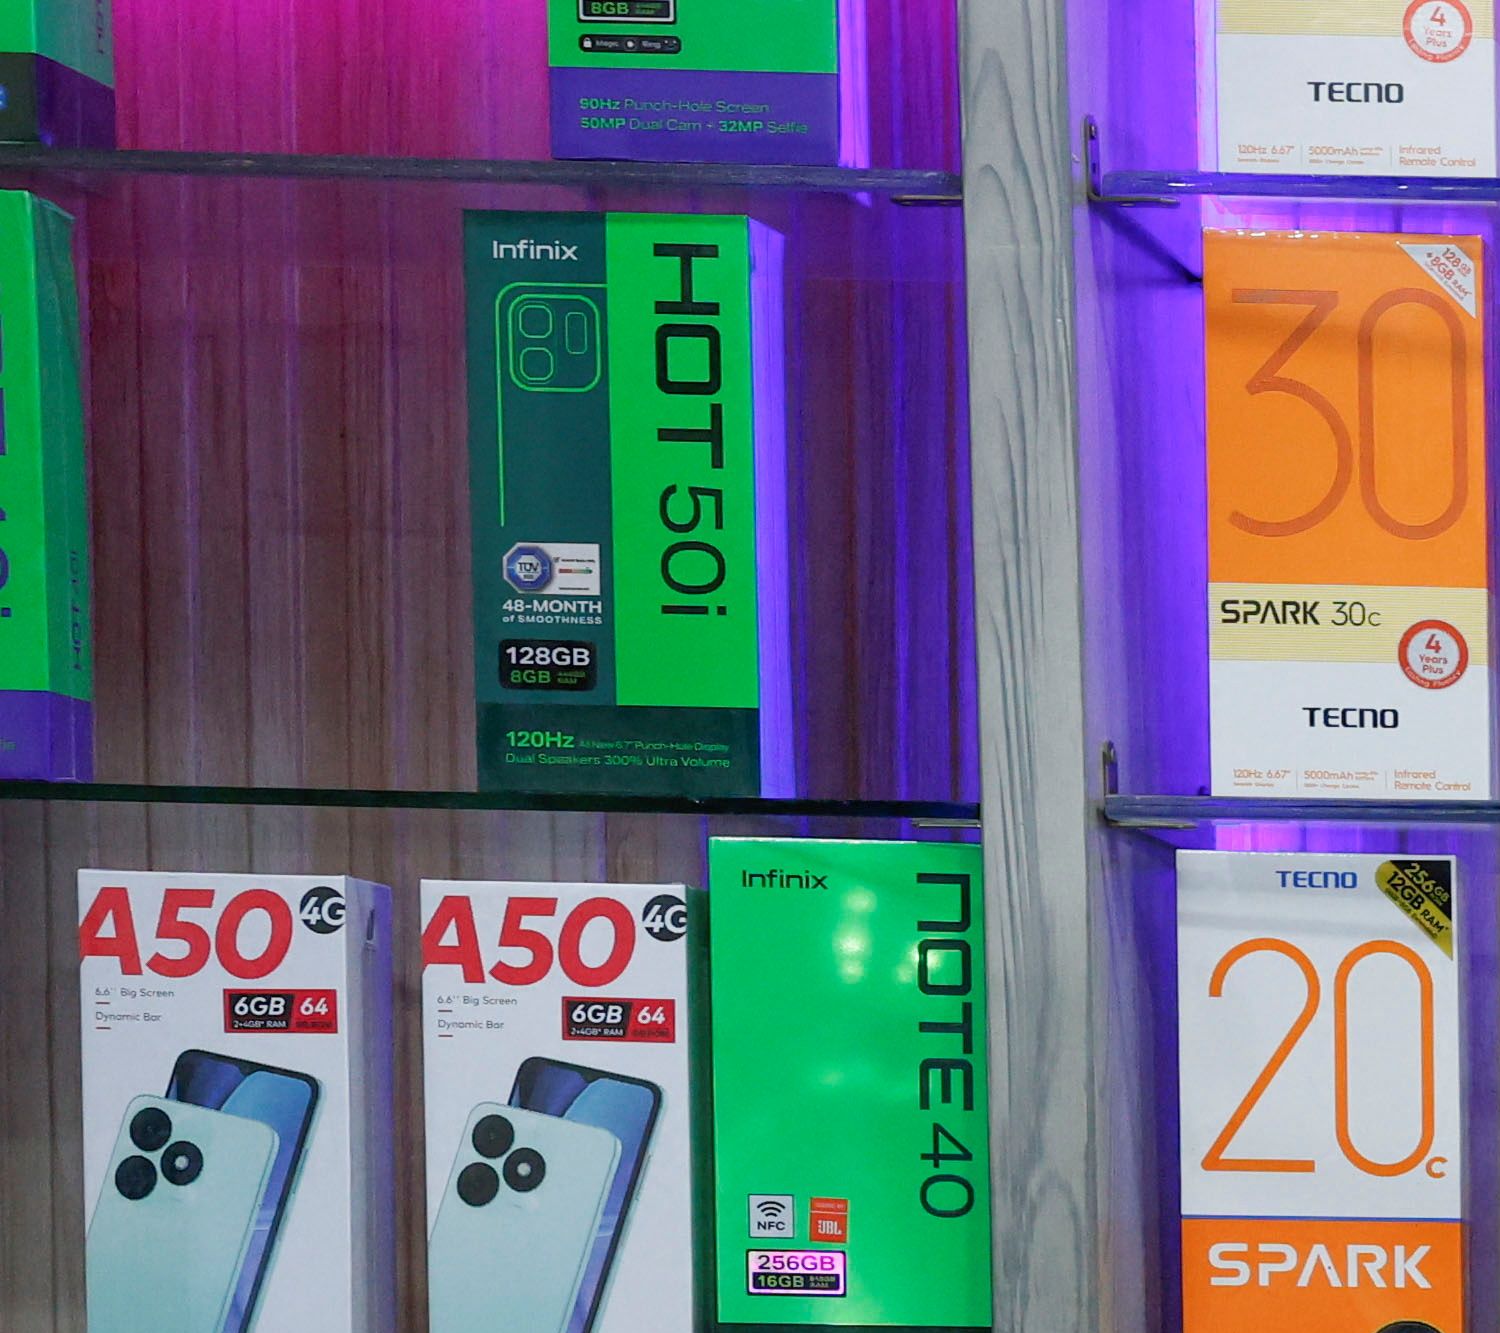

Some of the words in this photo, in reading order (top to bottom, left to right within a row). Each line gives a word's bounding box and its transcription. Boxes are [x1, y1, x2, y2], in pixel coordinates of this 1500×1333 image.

[1308, 82, 1404, 104] TECNO
[579, 98, 620, 110] 90Hz
[716, 100, 769, 113] Screen
[580, 117, 626, 128] 50MP
[719, 120, 763, 132] 32MP
[492, 240, 578, 260] Infinix
[652, 242, 724, 469] HOT
[1228, 287, 1469, 540] 30
[659, 484, 728, 616] 50i
[502, 599, 602, 614] 48-MONTH
[1221, 600, 1320, 625] SPARK
[502, 614, 516, 622] of
[518, 615, 602, 624] SMOOTHNESS
[1424, 634, 1442, 653] 4
[506, 647, 590, 666] 128GB
[1419, 654, 1448, 665] Years
[510, 670, 550, 684] 8GB
[1422, 665, 1444, 675] Plus
[1302, 708, 1398, 728] TECNO
[506, 731, 575, 748] 120Hz
[646, 756, 678, 766] Ultra
[682, 756, 730, 768] Volume
[1394, 770, 1436, 779] Infrared
[1394, 781, 1432, 790] Remote
[1435, 781, 1471, 791] Control
[742, 868, 828, 890] Infinix
[1276, 870, 1358, 890] TECNO
[79, 886, 293, 980] A50
[300, 896, 346, 926] 4G
[421, 895, 636, 988] A50
[120, 988, 137, 998] Big
[140, 988, 174, 998] Screen
[234, 997, 286, 1016] 6GB
[300, 998, 328, 1016] 64
[96, 1012, 140, 1022] Dynamic
[144, 1012, 162, 1022] Bar
[920, 1127, 975, 1218] 40
[757, 1220, 786, 1231] NFC
[818, 1220, 842, 1235] JBL
[758, 1254, 835, 1271] 256GB
[1208, 1242, 1432, 1288] SPARK
[758, 1275, 804, 1288] 16GB
